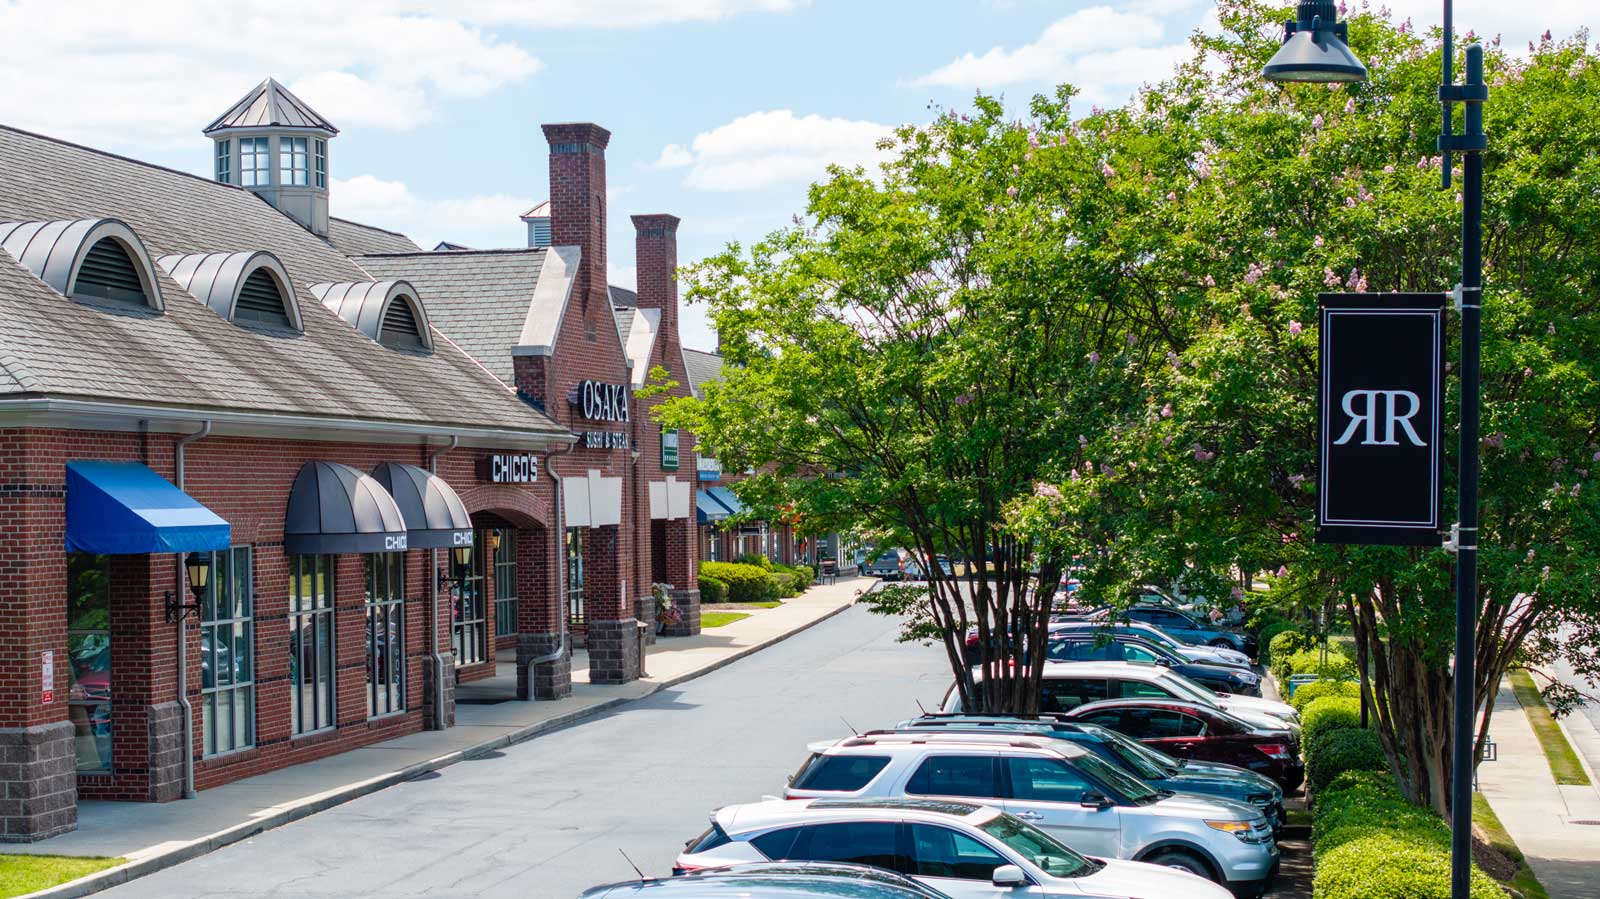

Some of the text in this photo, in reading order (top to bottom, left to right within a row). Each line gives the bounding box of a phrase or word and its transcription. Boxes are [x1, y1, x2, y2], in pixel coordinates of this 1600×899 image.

[583, 380, 629, 422] OSAKA
[586, 432, 603, 449] SUSHI
[605, 432, 610, 449] &
[492, 453, 538, 482] CHICO'S
